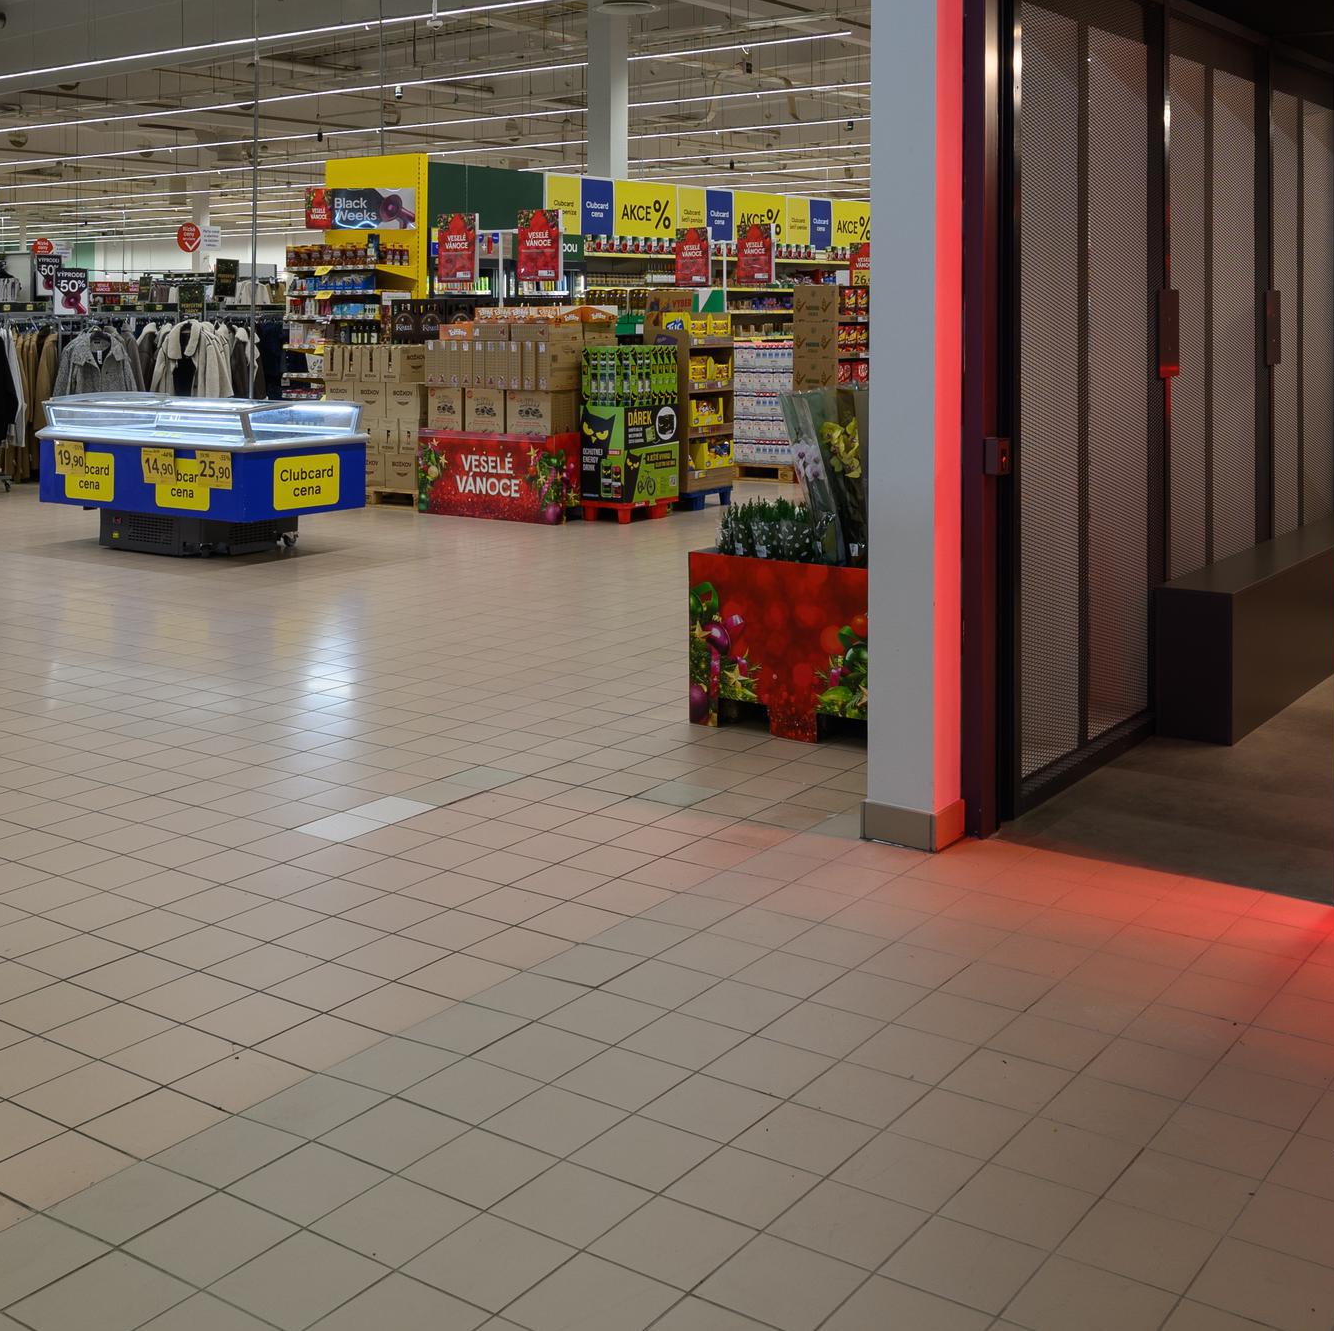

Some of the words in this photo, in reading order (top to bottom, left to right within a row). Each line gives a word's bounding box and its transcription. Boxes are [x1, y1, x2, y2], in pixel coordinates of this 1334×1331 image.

[334, 197, 368, 209] Black
[586, 201, 609, 210] Clubcard
[336, 210, 378, 221] Weeks
[621, 204, 652, 221] AKCE
[653, 199, 671, 230] %
[740, 213, 765, 225] AKCE
[837, 220, 858, 234] AKCE
[447, 233, 467, 241] VESELÉ
[528, 230, 549, 239] VESELÉ
[445, 241, 468, 250] VÁNOCE
[525, 238, 552, 247] VÁNOCE
[683, 243, 701, 251] VESELÉ
[57, 279, 86, 292] -50%
[628, 409, 652, 427] DÁREK
[58, 450, 84, 468] 19,90
[461, 452, 514, 474] VESELÉ
[85, 465, 110, 476] bcard
[145, 458, 174, 476] 14,90
[199, 460, 231, 481] 25,90
[176, 470, 198, 483] bcar
[280, 465, 334, 482] Clubcard
[78, 479, 100, 490] cena
[456, 472, 520, 497] VÁNOCE
[170, 487, 194, 499] cena
[293, 485, 321, 497] cena
